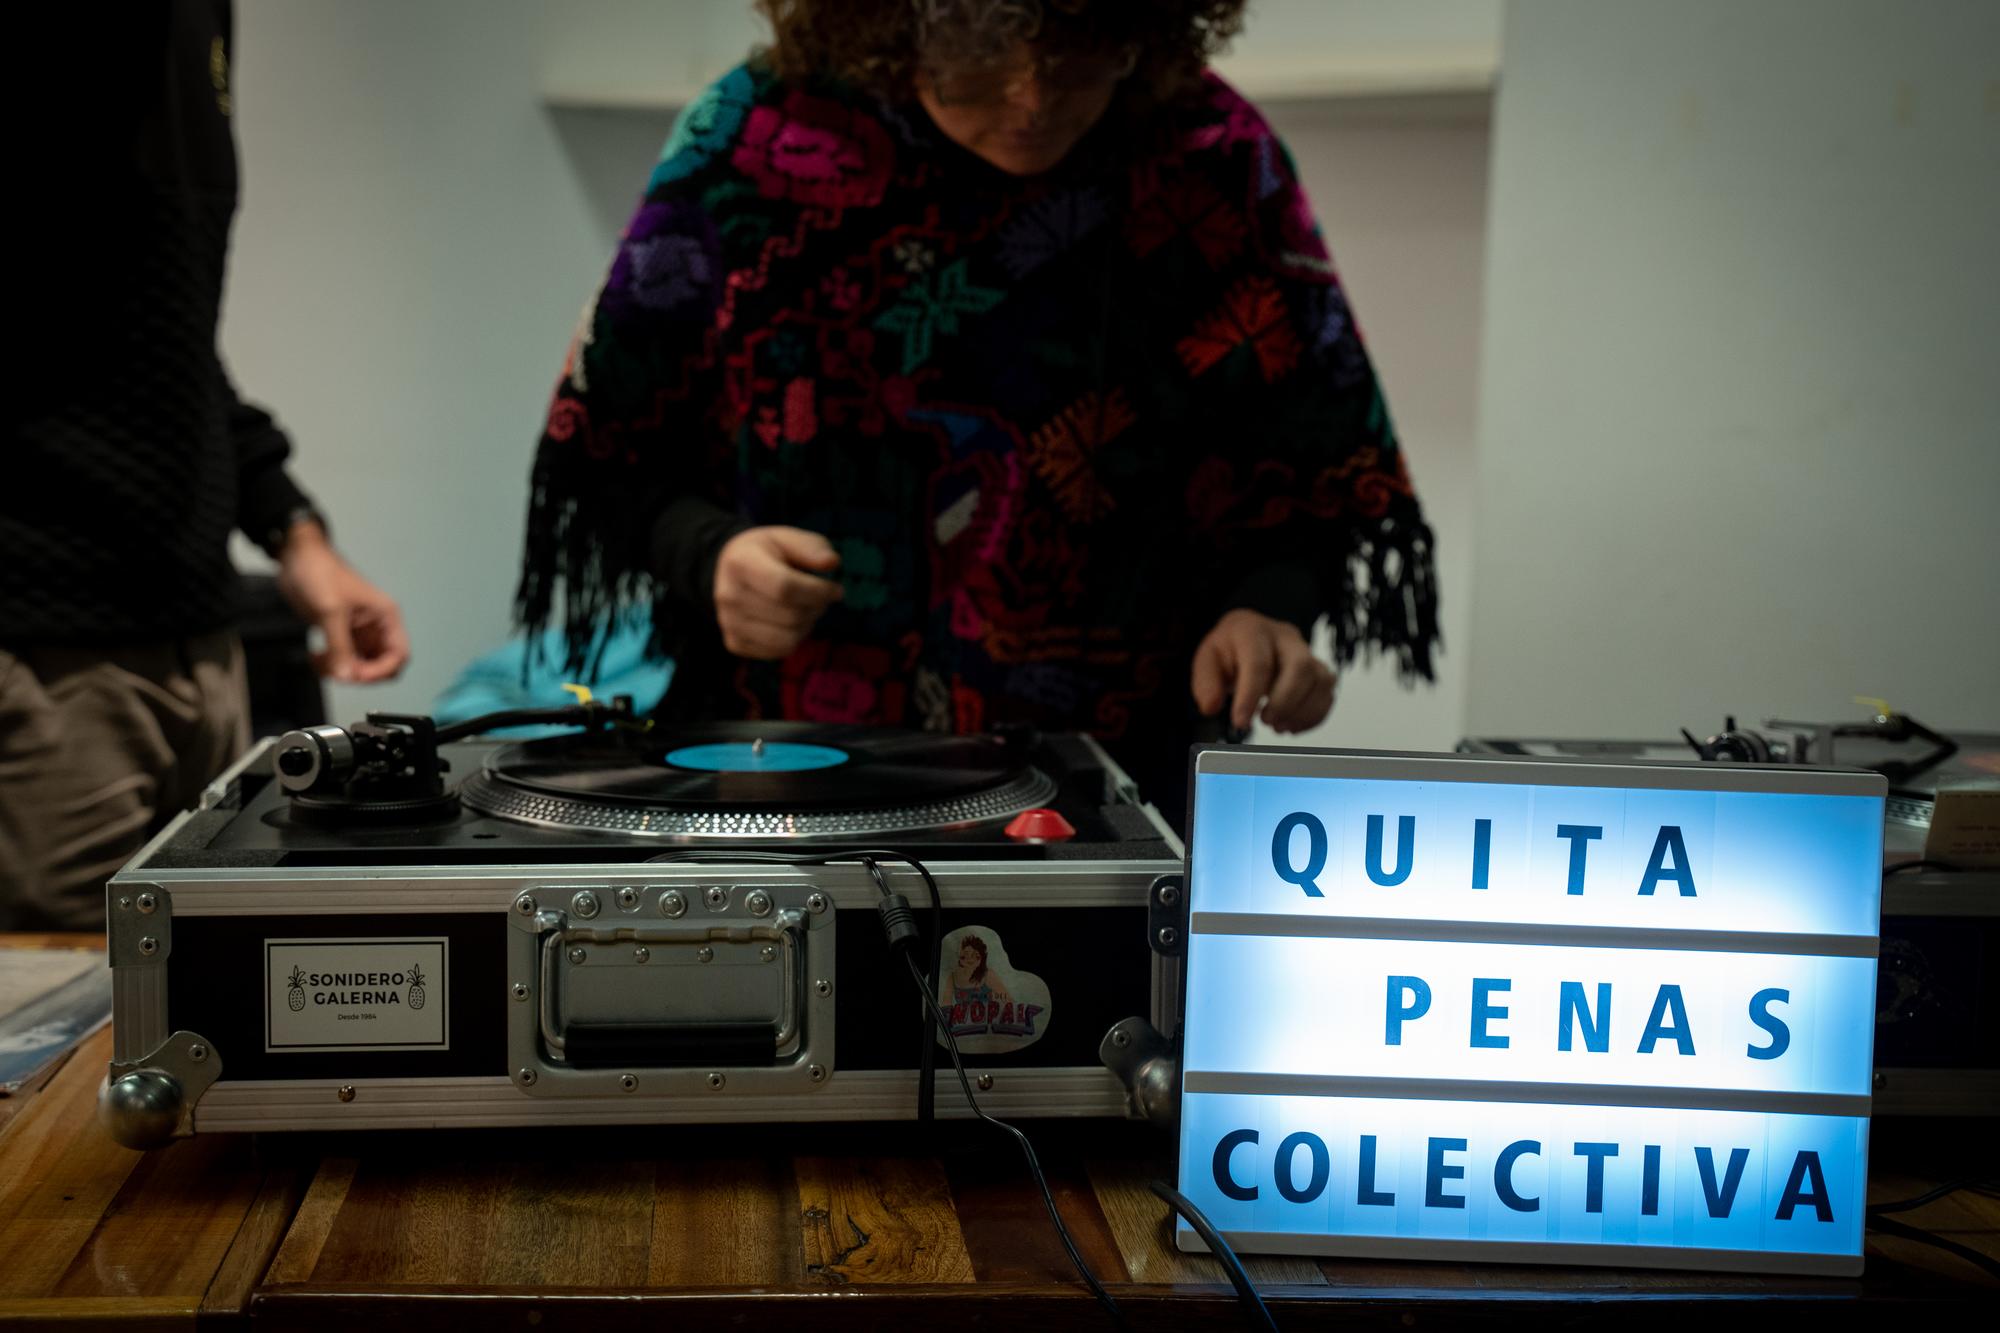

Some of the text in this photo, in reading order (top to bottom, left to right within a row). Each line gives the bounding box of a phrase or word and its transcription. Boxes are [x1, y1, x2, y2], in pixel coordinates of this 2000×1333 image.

[1271, 811, 1698, 898] QUITA
[309, 973, 404, 986] SONIDERO
[314, 991, 400, 1005] GALERNA
[1384, 974, 1791, 1061] PENAS
[1212, 1129, 1835, 1224] COLECTIVA
